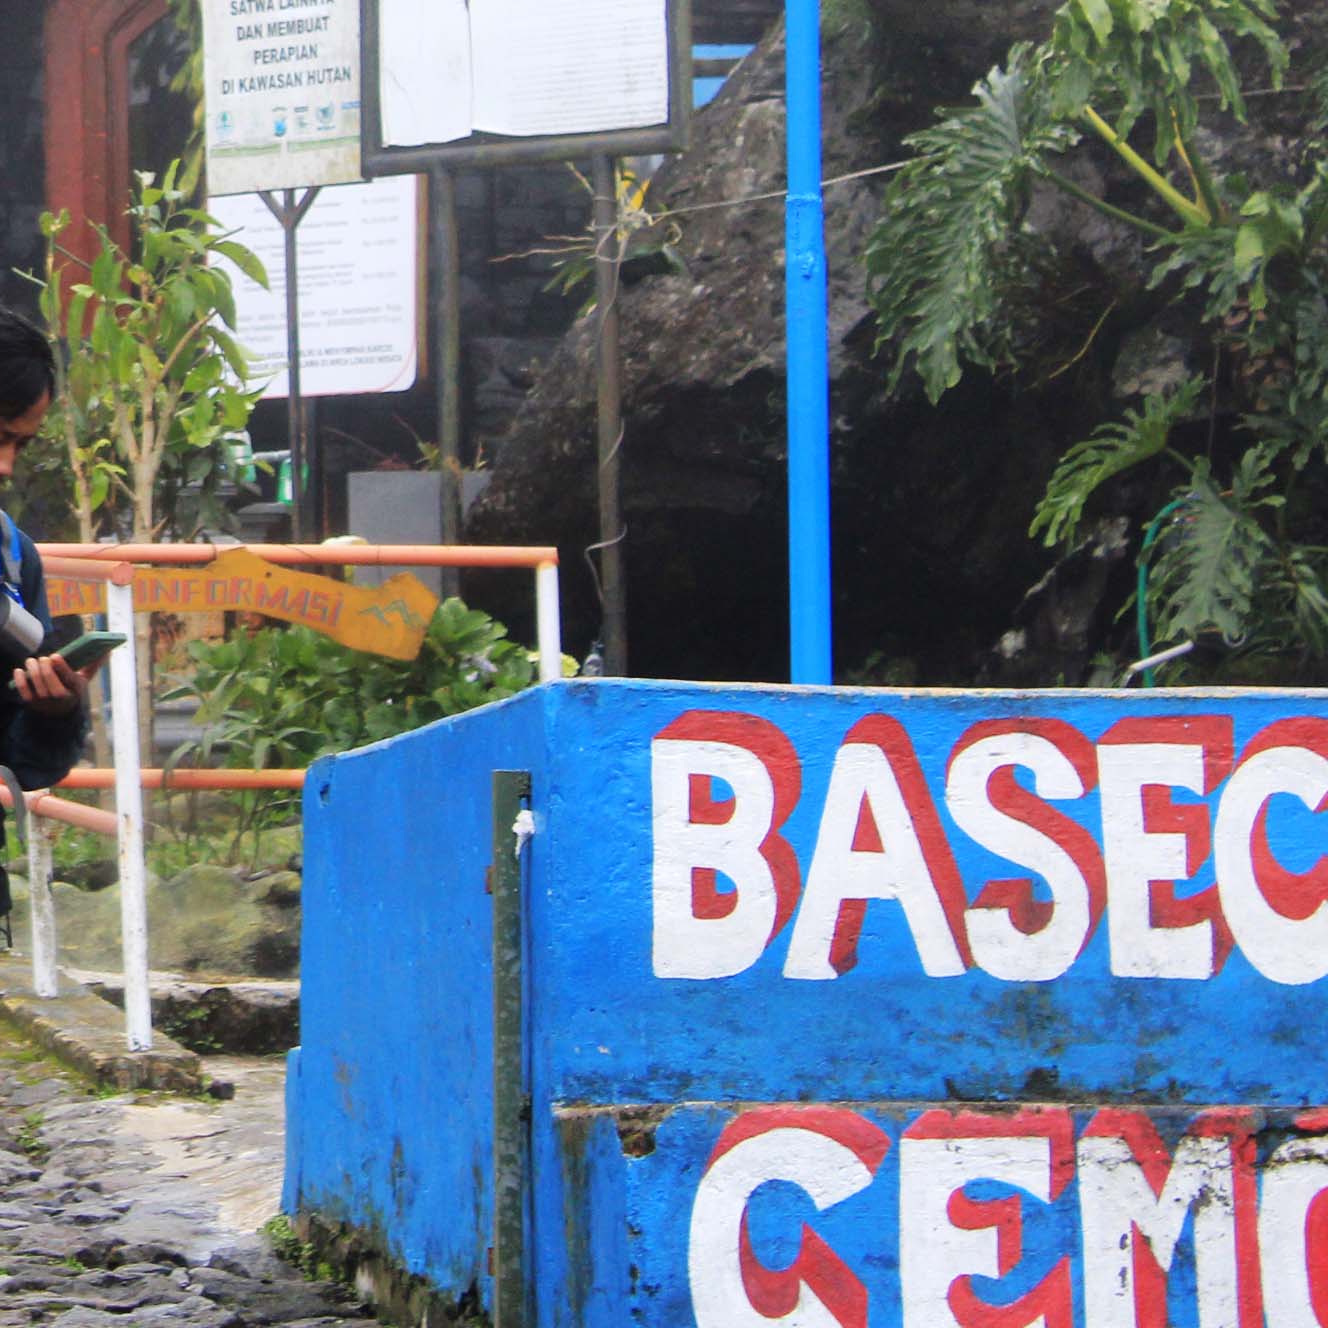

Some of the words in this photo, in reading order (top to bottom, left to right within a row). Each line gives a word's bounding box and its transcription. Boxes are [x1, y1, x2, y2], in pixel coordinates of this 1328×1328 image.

[237, 26, 263, 41] DAN
[268, 16, 330, 37] MEMBUAT
[254, 44, 318, 65] PERAPIAN
[222, 79, 235, 95] DI
[239, 71, 303, 94] KAWASAN
[307, 66, 352, 85] HUTAN
